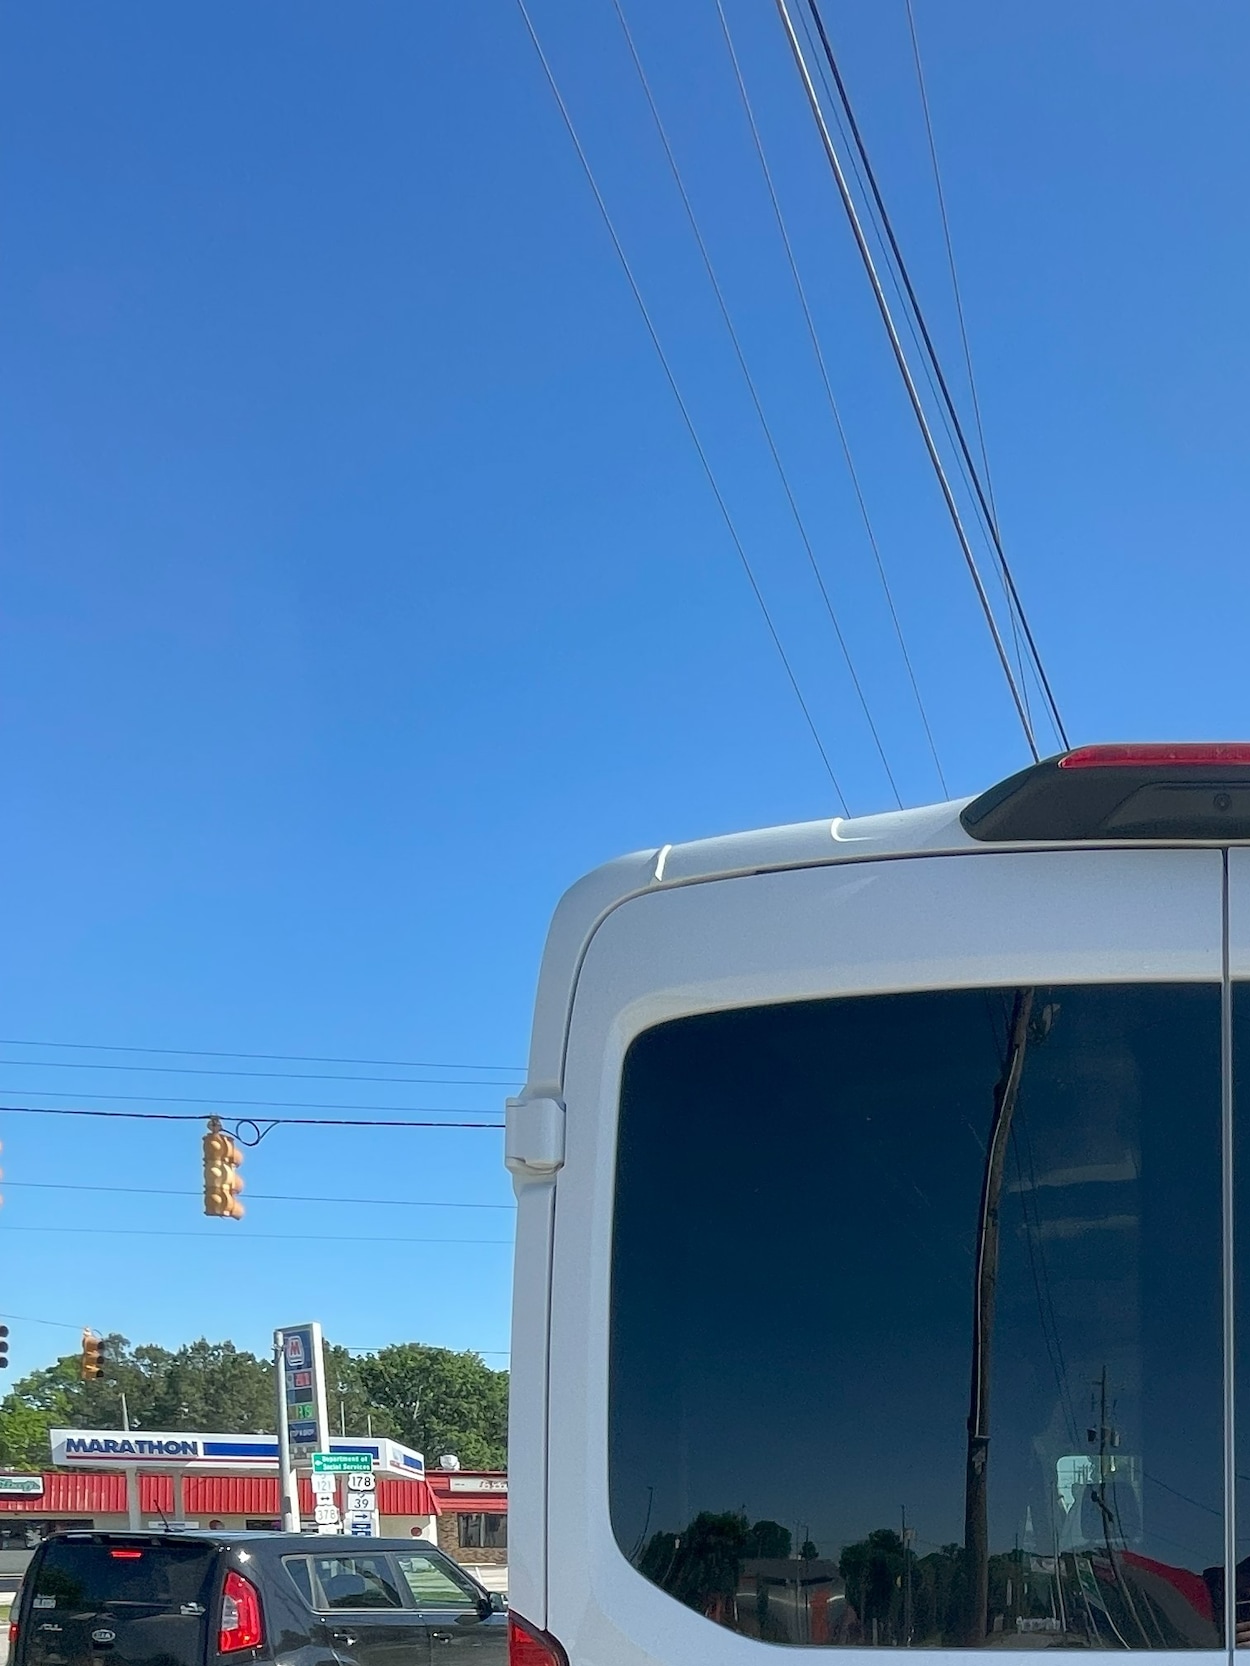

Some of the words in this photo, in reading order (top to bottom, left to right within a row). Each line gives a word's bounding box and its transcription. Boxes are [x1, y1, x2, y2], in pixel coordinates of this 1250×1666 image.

[66, 1438, 198, 1456] MARATHON
[317, 1481, 331, 1491] 121
[352, 1476, 371, 1487] 178
[354, 1498, 369, 1508] 39
[318, 1509, 336, 1520] 378
